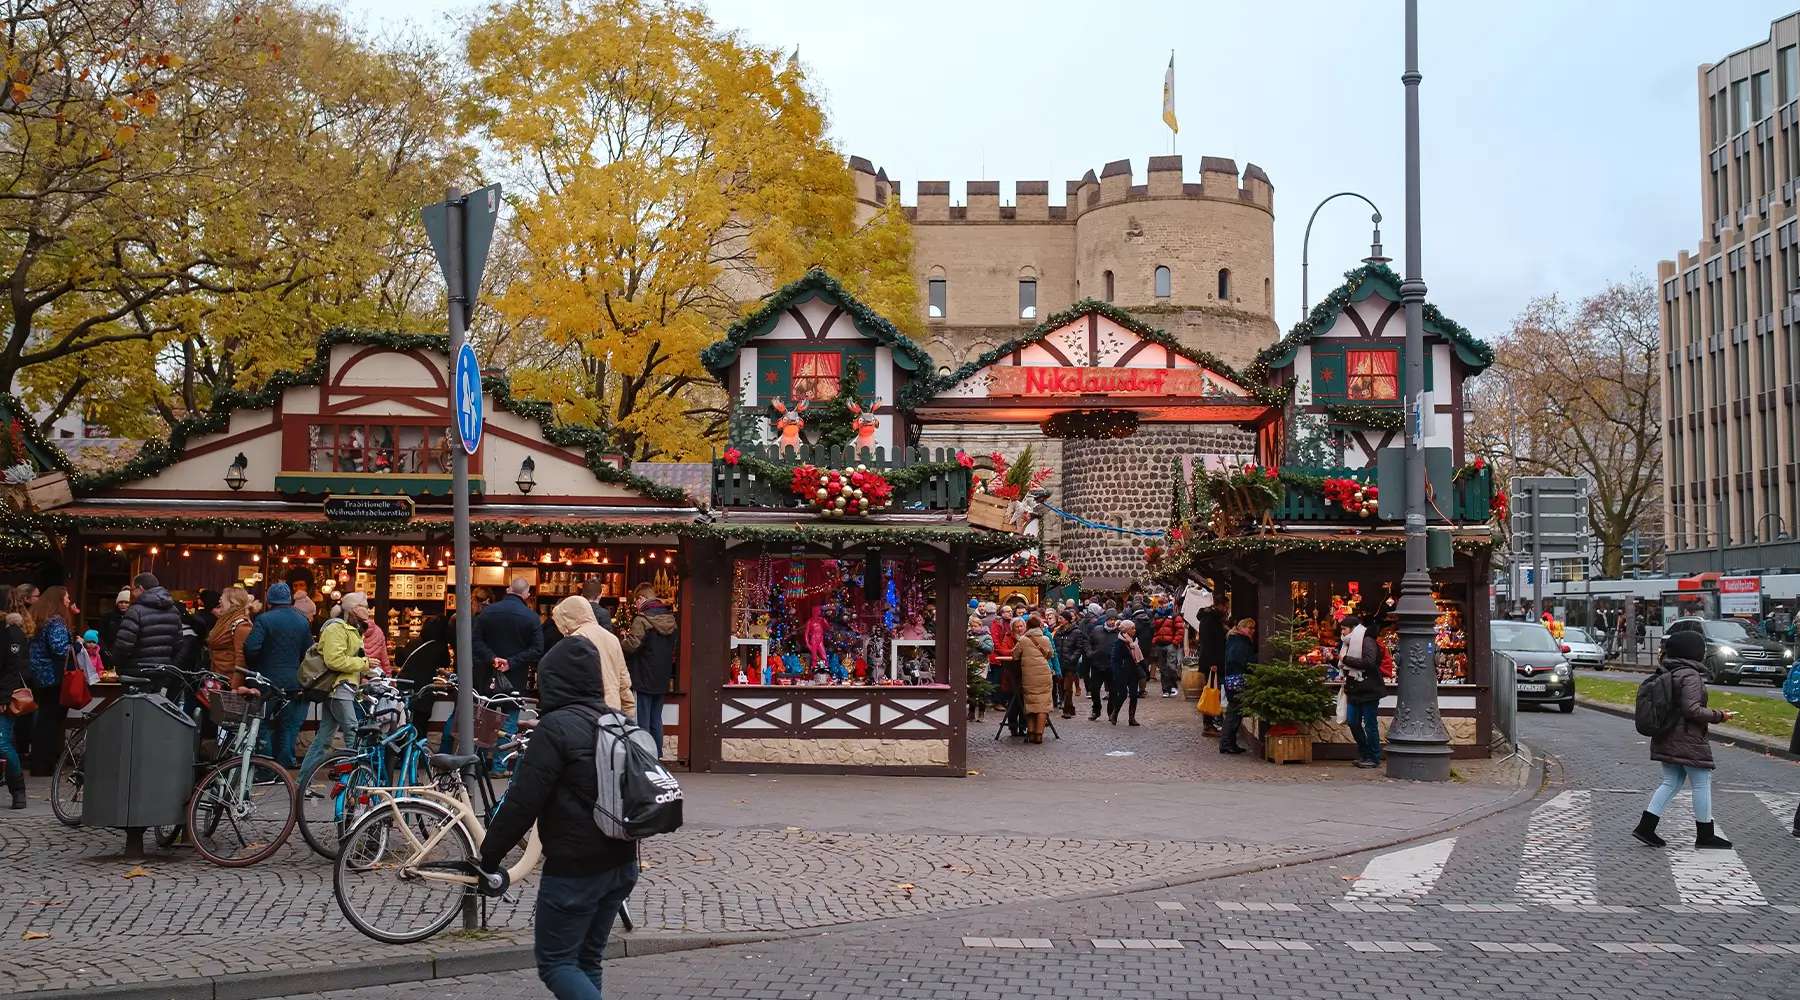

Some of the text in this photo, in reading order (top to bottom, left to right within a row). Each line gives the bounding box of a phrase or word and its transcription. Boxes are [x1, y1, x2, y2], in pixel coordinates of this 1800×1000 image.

[1026, 368, 1168, 393] Nikolausdorf
[343, 500, 391, 508] Traditionelle
[326, 508, 410, 517] Weihnachtsdekoration
